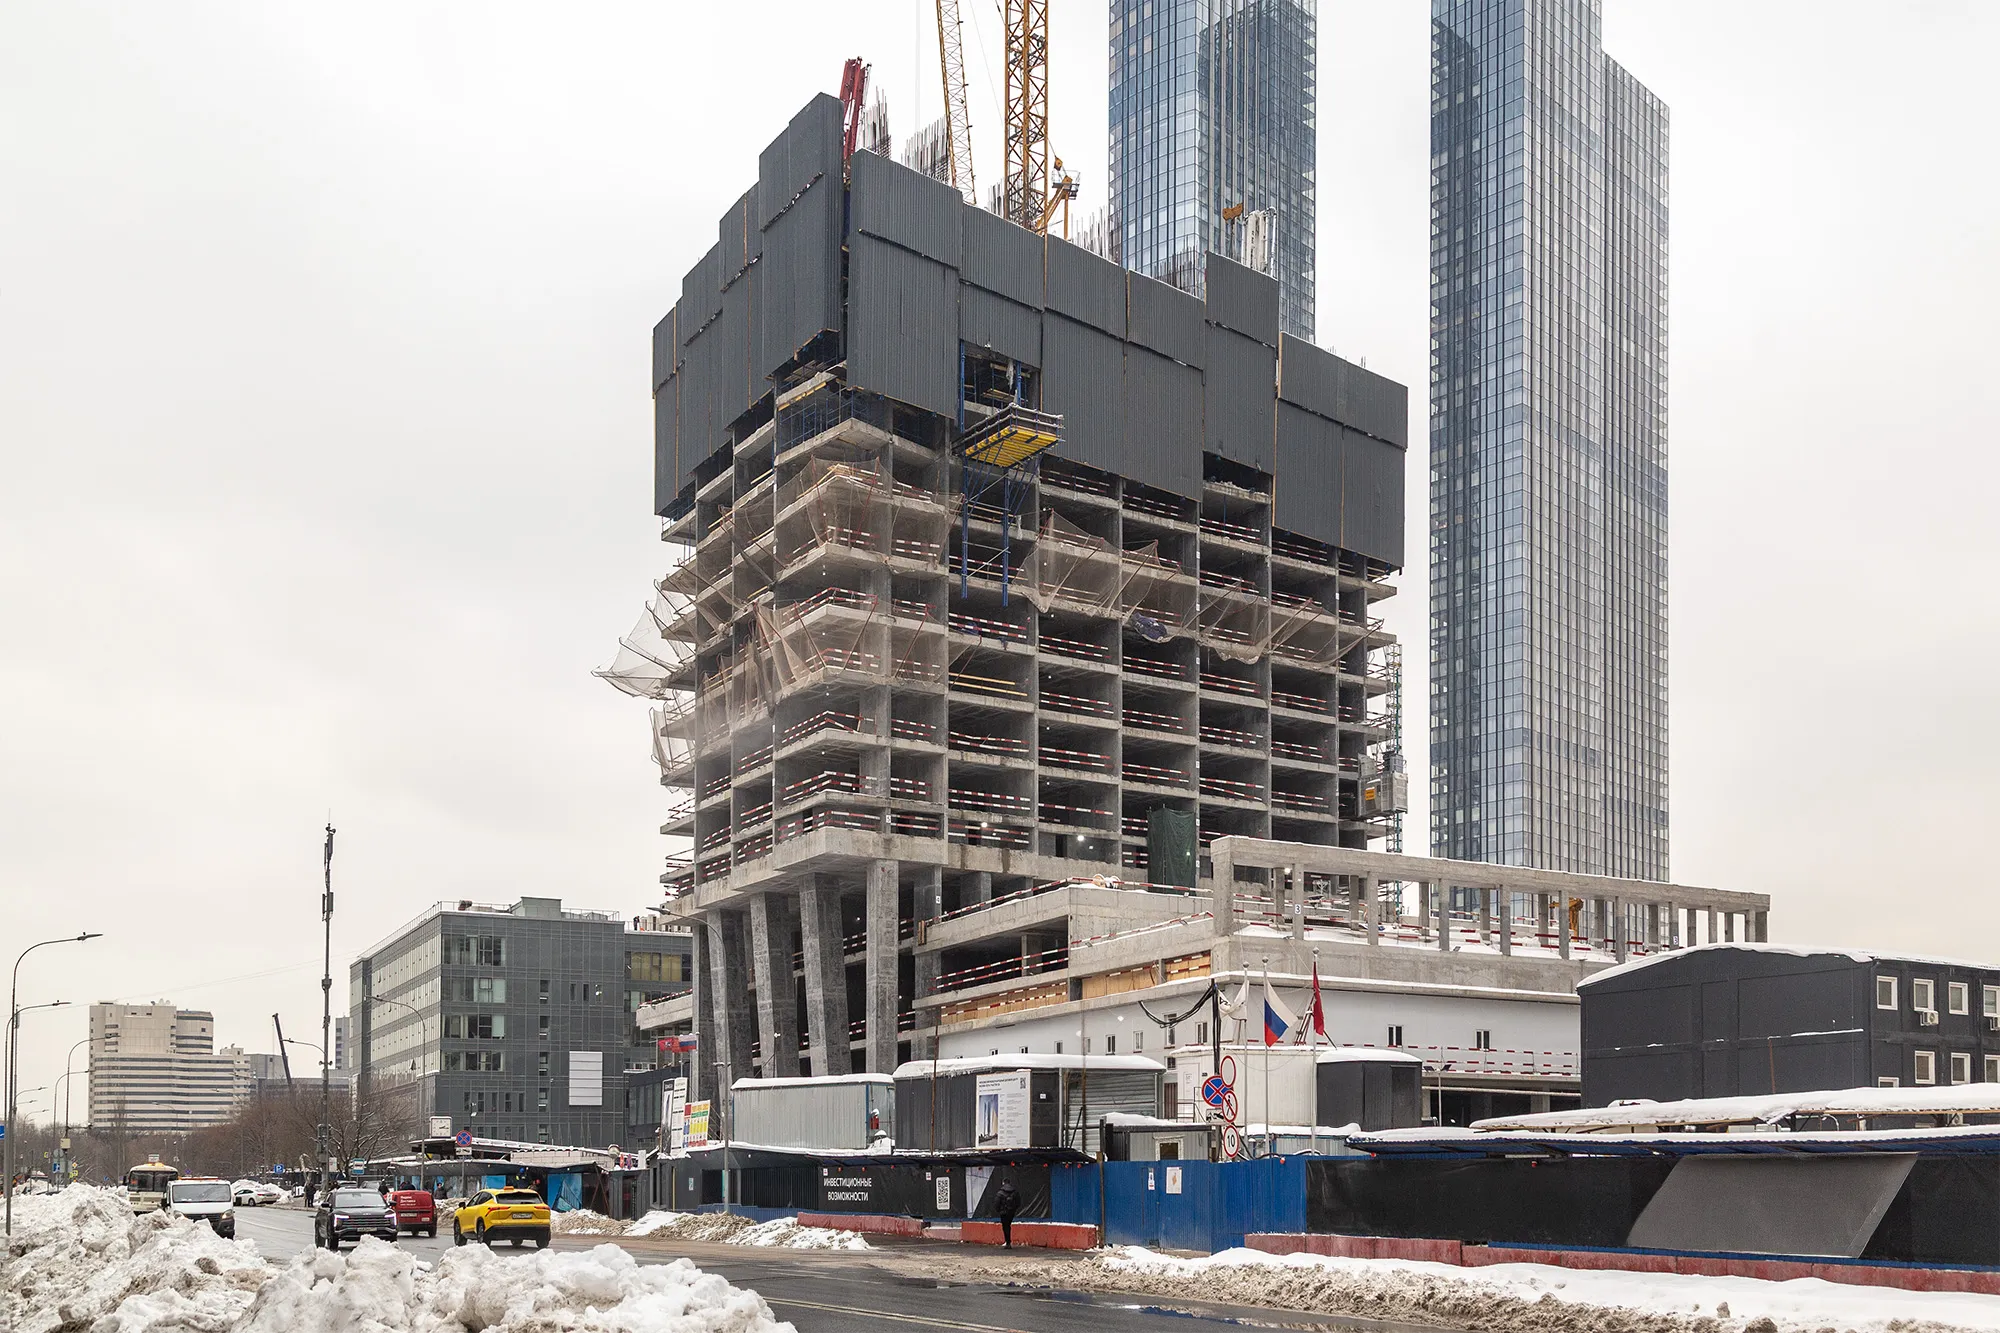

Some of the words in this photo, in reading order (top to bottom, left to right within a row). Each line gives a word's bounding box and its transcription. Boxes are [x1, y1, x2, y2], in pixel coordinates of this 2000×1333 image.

[1296, 904, 1301, 914] 3
[1227, 1134, 1235, 1147] 10
[824, 1178, 872, 1188] ИНВЕСТИЦИОННЫЕ
[828, 1192, 869, 1201] ВОЗМОЖНОСТИ
